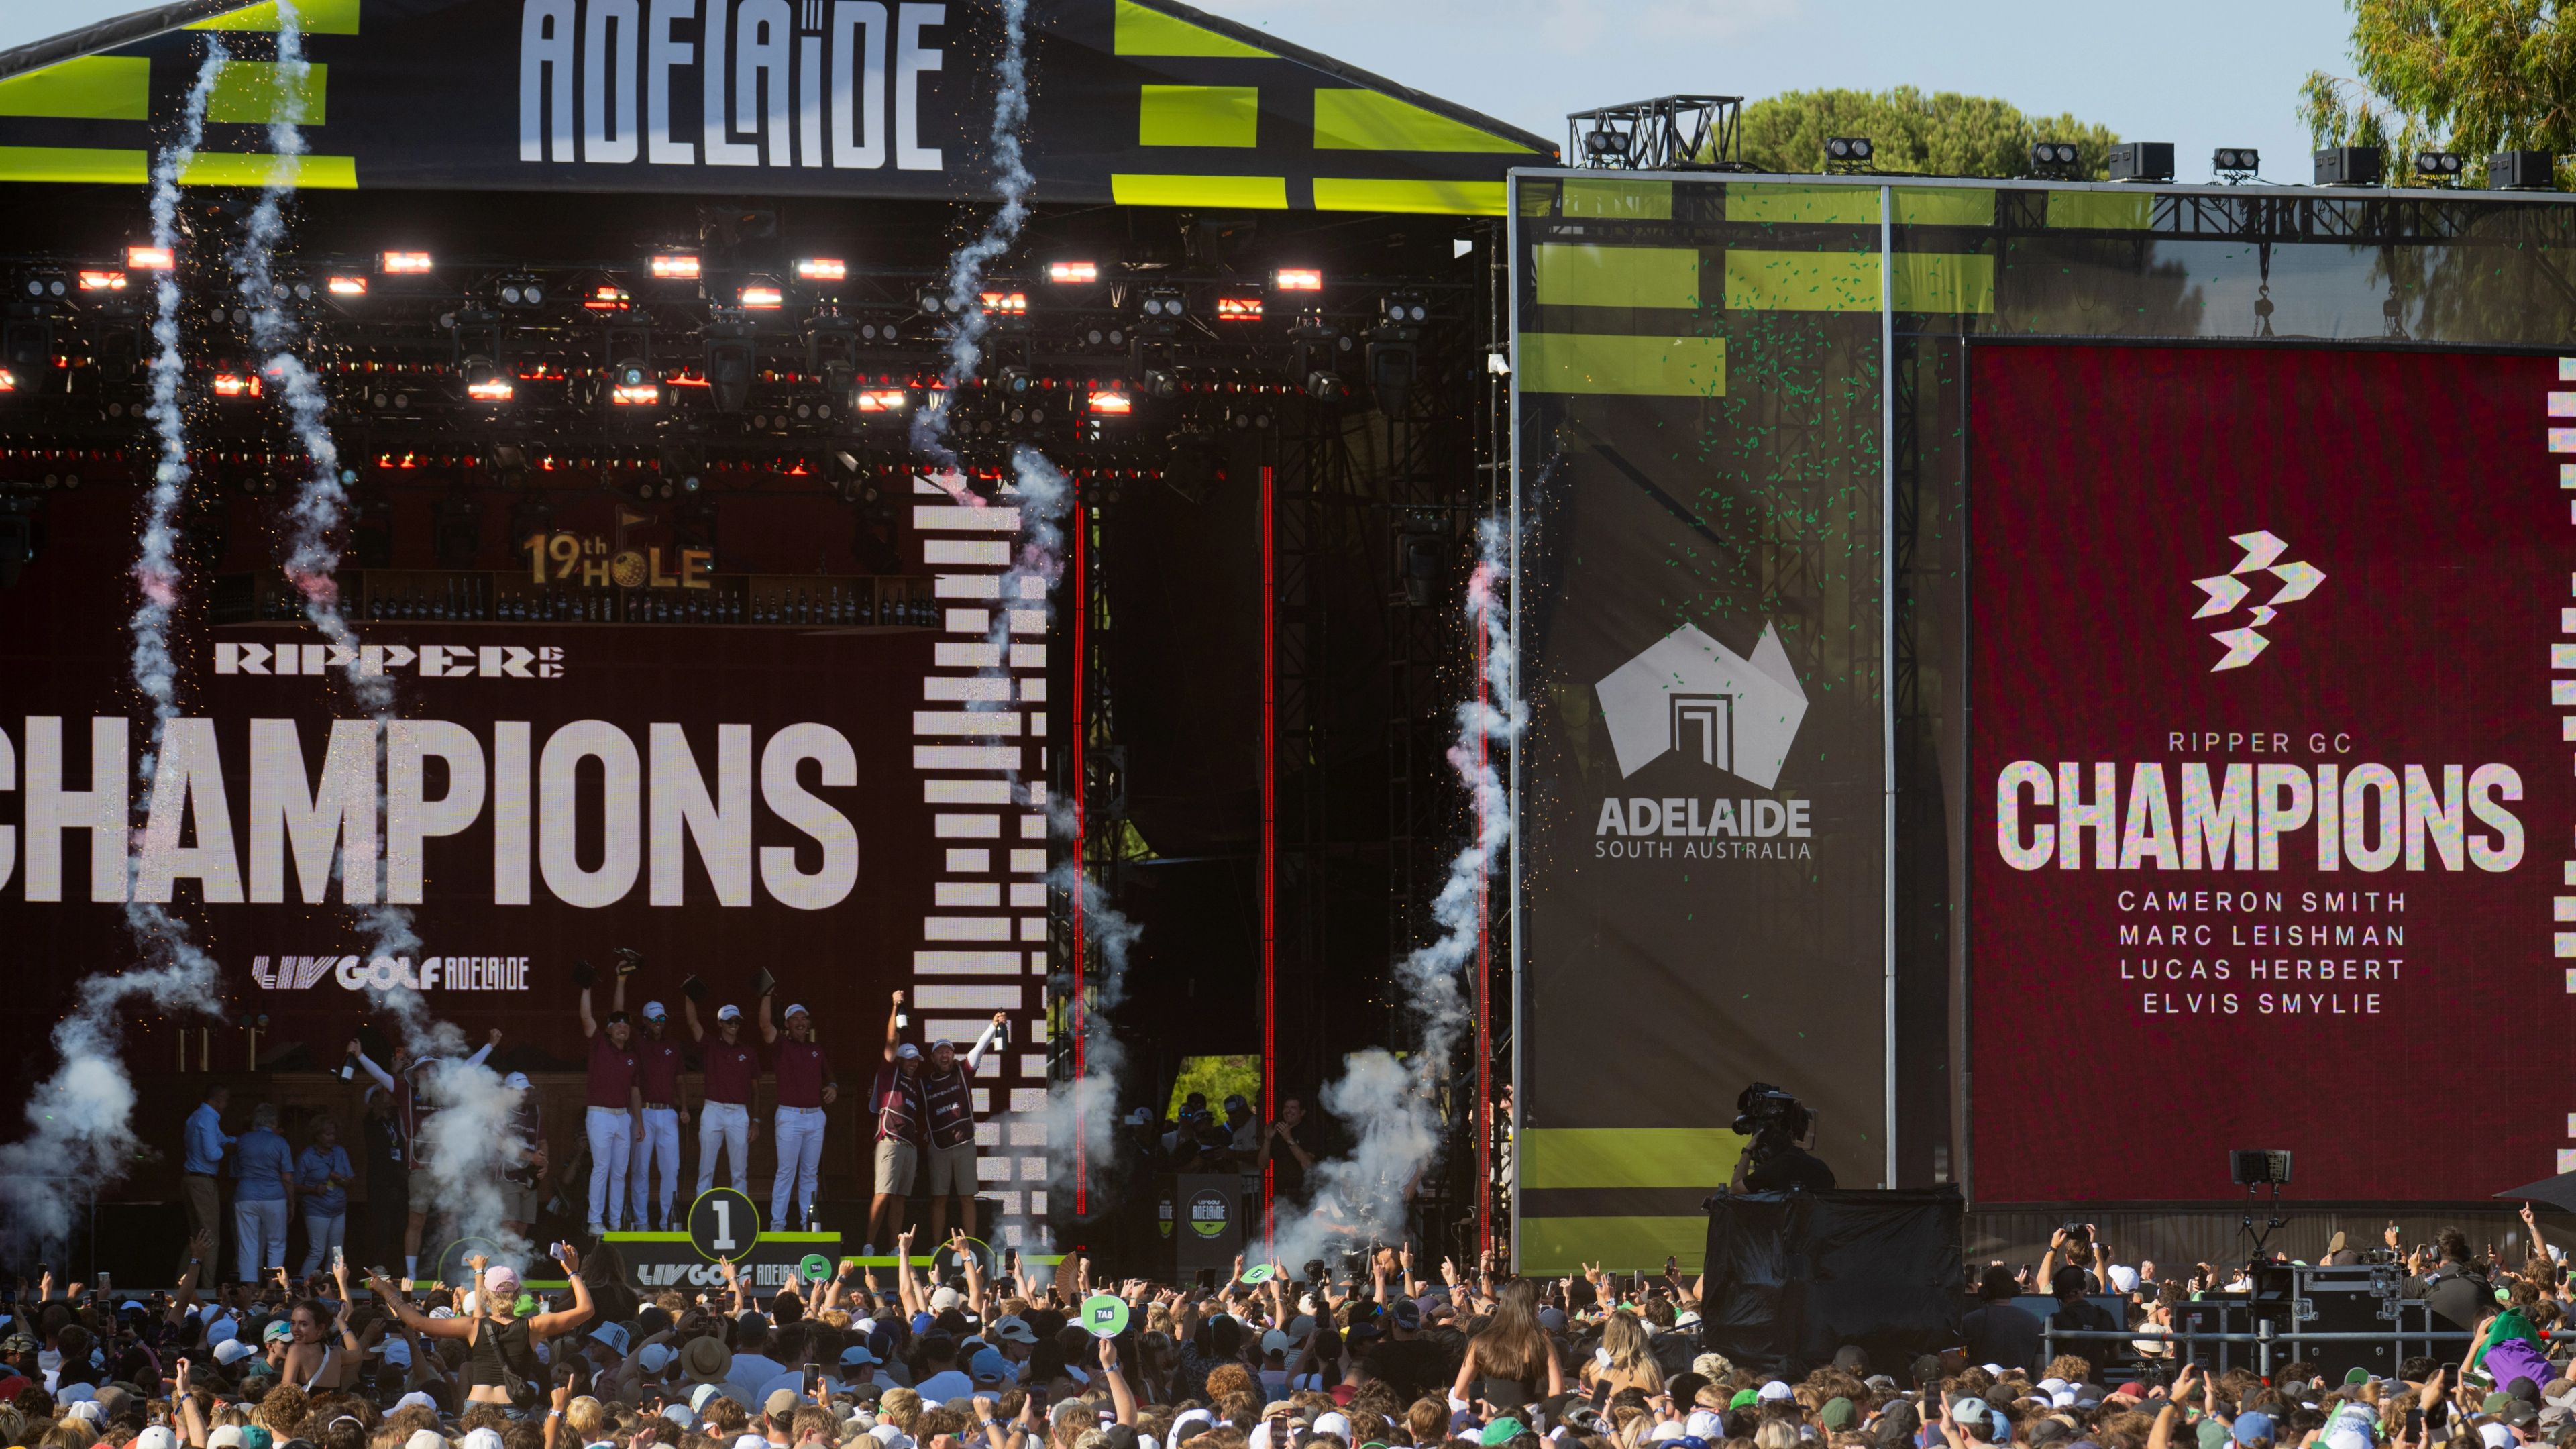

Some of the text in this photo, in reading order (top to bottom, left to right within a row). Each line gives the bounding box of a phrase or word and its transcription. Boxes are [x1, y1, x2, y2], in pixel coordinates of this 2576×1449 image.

[524, 535, 607, 582] 19th
[215, 643, 536, 678] RIPPER
[2169, 732, 2351, 753] RIPPER GC
[1595, 798, 1811, 837] ADELAIDE
[1997, 760, 2525, 873] CHAMPIONS
[1595, 841, 1811, 859] SOUTH AUSTRALIA
[2118, 890, 2405, 912] CAMERON SMITH
[2120, 924, 2404, 946] MARC LEISHMAN
[336, 955, 441, 991] GOLF
[445, 956, 529, 991] ADELAIDE
[2121, 959, 2404, 980] LUCAS HERBERT
[2144, 993, 2380, 1014] ELVIS SMYLIE
[712, 1200, 735, 1250] 1
[1097, 1310, 1113, 1319] TAB
